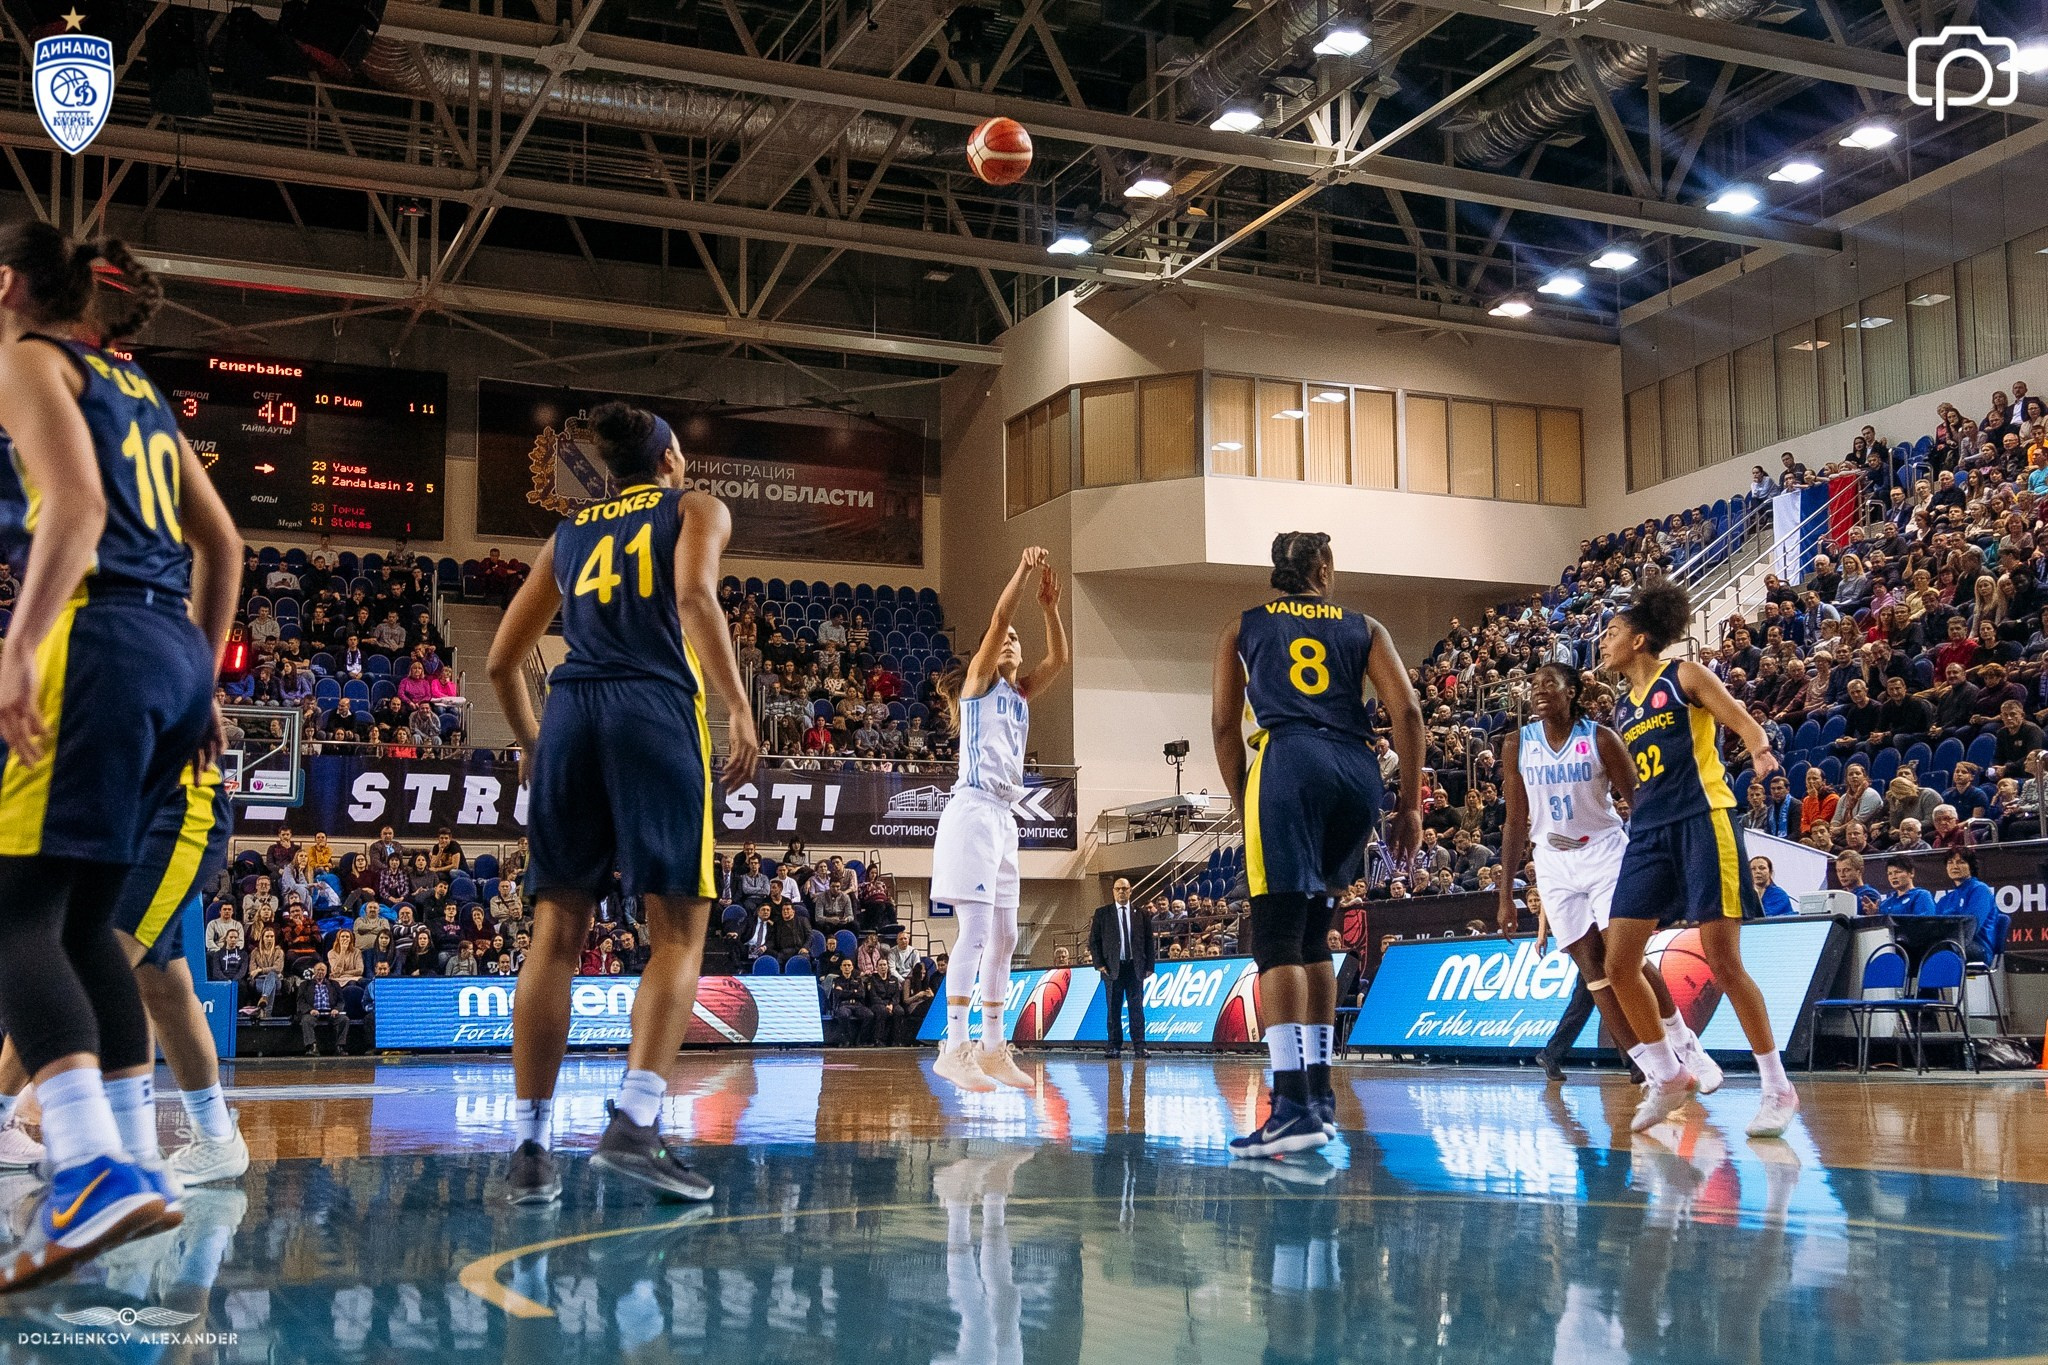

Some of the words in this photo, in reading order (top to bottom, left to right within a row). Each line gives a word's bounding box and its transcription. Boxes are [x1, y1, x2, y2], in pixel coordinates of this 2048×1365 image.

[209, 358, 303, 377] Fenerbahce
[172, 389, 210, 401] ПЕРИОД
[252, 391, 283, 402] СЧЕТ
[315, 394, 329, 405] 10
[334, 395, 363, 408] Plum
[409, 402, 415, 412] 1
[422, 404, 435, 414] 11
[183, 398, 197, 417] 3
[258, 400, 297, 425] 40
[241, 424, 293, 435] ТАЙМ-АУТЫ
[312, 461, 327, 471] 23
[332, 462, 368, 475] Yavas
[684, 459, 795, 481] ИНИСТРАЦИЯ
[121, 420, 183, 545] 10
[311, 474, 326, 485] 24
[332, 476, 401, 491] Zandalasin
[406, 482, 414, 492] 2
[426, 483, 434, 493] 5
[683, 477, 759, 500] РСКОЙ
[765, 483, 875, 508] ОБЛАСТИ
[250, 495, 278, 504] ФОЛЫ
[311, 502, 325, 512] 33
[575, 491, 663, 526] STOKES
[310, 516, 323, 526] 41
[574, 523, 653, 604] 41
[1265, 601, 1343, 620] VAUGHN
[1289, 637, 1330, 695] 8
[1636, 744, 1665, 782] 32
[1526, 762, 1592, 786] DYNAMO
[1549, 794, 1574, 821] 31
[869, 824, 938, 836] СПОРТИВНО-
[453, 1023, 492, 1043] For
[493, 1022, 514, 1040] th
[1163, 1021, 1204, 1042] game
[1405, 1011, 1443, 1039] For
[1438, 1009, 1472, 1037] the
[1471, 1009, 1524, 1037] real
